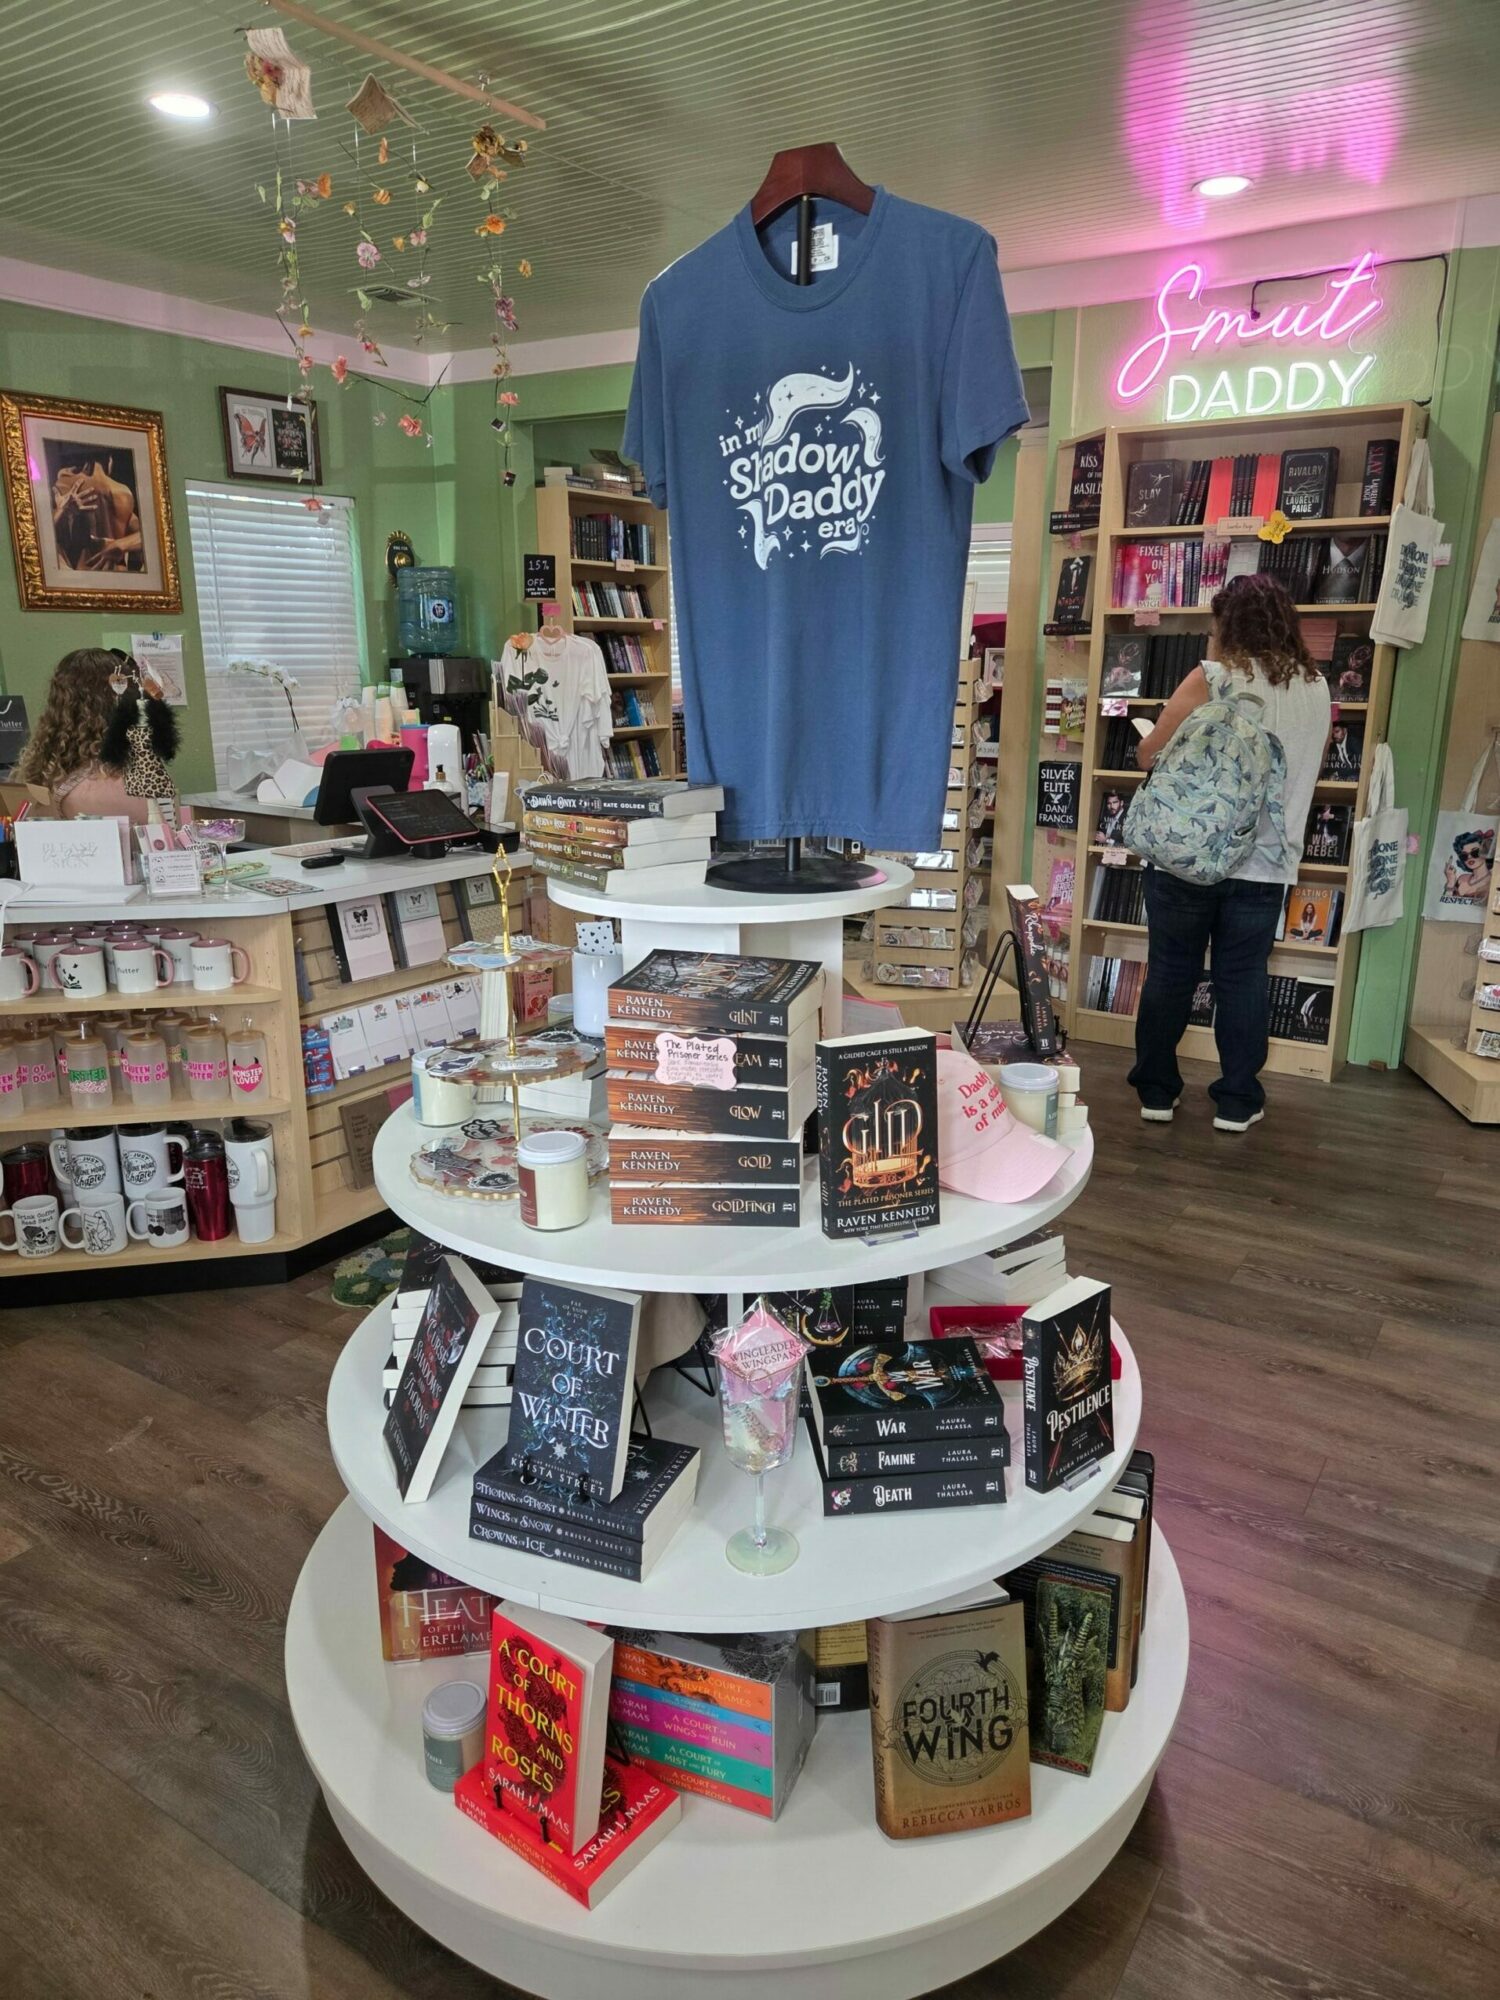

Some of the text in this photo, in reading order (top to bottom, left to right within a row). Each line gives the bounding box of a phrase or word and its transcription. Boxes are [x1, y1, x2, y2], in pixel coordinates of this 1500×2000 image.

[1117, 252, 1380, 397] Smut
[1166, 356, 1373, 420] DADDY
[719, 419, 764, 456] in m
[1081, 455, 1097, 467] KISS
[1374, 447, 1383, 477] SLAY
[1289, 465, 1322, 477] RIVALRY
[764, 466, 885, 524] Daddy
[1074, 483, 1103, 494] BASILI
[1139, 488, 1162, 500] SLAY
[1286, 494, 1319, 505] LAURELIN
[1292, 504, 1312, 513] PAIGE
[819, 517, 856, 538] era
[529, 560, 549, 570] 15%
[1322, 566, 1360, 574] HUDSON
[1041, 769, 1075, 780] SILVER
[1044, 782, 1071, 793] ELITE
[1045, 804, 1067, 814] DANI
[1039, 813, 1073, 823] FRANCIS
[42, 842, 96, 852] PLEASE
[1307, 845, 1340, 857] REBEL
[54, 859, 89, 868] SIGN
[593, 852, 612, 860] GOLDEN
[1295, 889, 1328, 897] DATING
[626, 995, 663, 1006] RAVEN
[617, 1005, 673, 1019] KENNEDY
[729, 1009, 762, 1025] GLINT
[665, 1040, 720, 1054] The Plated
[668, 1048, 729, 1061] Prisoner series
[843, 1051, 866, 1060] GILDED
[908, 1044, 928, 1052] PRISON
[233, 1067, 262, 1077] MONSTER
[236, 1075, 260, 1084] LOVER
[958, 1072, 992, 1099] Daddy
[628, 1093, 665, 1103] RAVEN
[620, 1101, 675, 1115] KENNEDY
[729, 1105, 762, 1120] GLOW
[962, 1099, 988, 1119] is a
[843, 1100, 924, 1157] GILD
[975, 1114, 989, 1132] of
[631, 1151, 670, 1160] RAVEN
[738, 1154, 772, 1170] GOLD
[622, 1161, 681, 1171] KENNEDY
[632, 1198, 671, 1206] RAVEN
[838, 1188, 934, 1207] THE PLATED PRISONER SERIES
[37, 1209, 55, 1218] Coffee
[623, 1207, 682, 1216] KENNEDY
[712, 1199, 776, 1215] GOLDFINCH
[837, 1204, 936, 1228] RAVEN KENNEDY
[524, 1328, 619, 1379] COURT
[742, 1349, 803, 1369] WINGSPANS
[413, 1340, 442, 1399] SHADOWS
[552, 1373, 583, 1398] OF
[1023, 1356, 1040, 1412] PESTILENCE
[519, 1392, 610, 1449] WINTER
[1046, 1385, 1111, 1442] PESTILENCE
[878, 1451, 915, 1470] FAMINE
[636, 1449, 692, 1515] KRISTA STREET
[873, 1485, 912, 1507] DEATH
[476, 1481, 626, 1532] THORNS FROST KRISTA STREET
[476, 1502, 624, 1552] WINGS SNOW KRISTA STREET
[473, 1523, 623, 1573] CROWNS KRISTA STREET
[401, 1589, 491, 1629] HEAT
[427, 1625, 443, 1633] OF
[402, 1632, 493, 1650] EVERFLAME
[498, 1639, 510, 1657] A
[517, 1649, 576, 1701] COURT
[513, 1673, 531, 1691] OF
[708, 1676, 742, 1692] COURT
[903, 1685, 1010, 1727] FOURTH
[496, 1683, 573, 1754] THORNS
[623, 1708, 650, 1722] MAAS
[682, 1717, 719, 1733] COURT
[663, 1721, 736, 1750] WINGS RUIN
[903, 1715, 1014, 1764] WING
[623, 1740, 650, 1755] MAAS
[492, 1734, 554, 1793] ROSES
[536, 1743, 563, 1770] AND
[678, 1748, 713, 1765] COURT
[664, 1753, 726, 1780] MIST FURY
[680, 1773, 711, 1788] COURT
[659, 1775, 732, 1804] THORNS ROSES
[488, 1768, 570, 1835] SARAH MAAS
[902, 1799, 1022, 1829] REBECCA YARROS
[574, 1785, 660, 1871] SARAH MAAS
